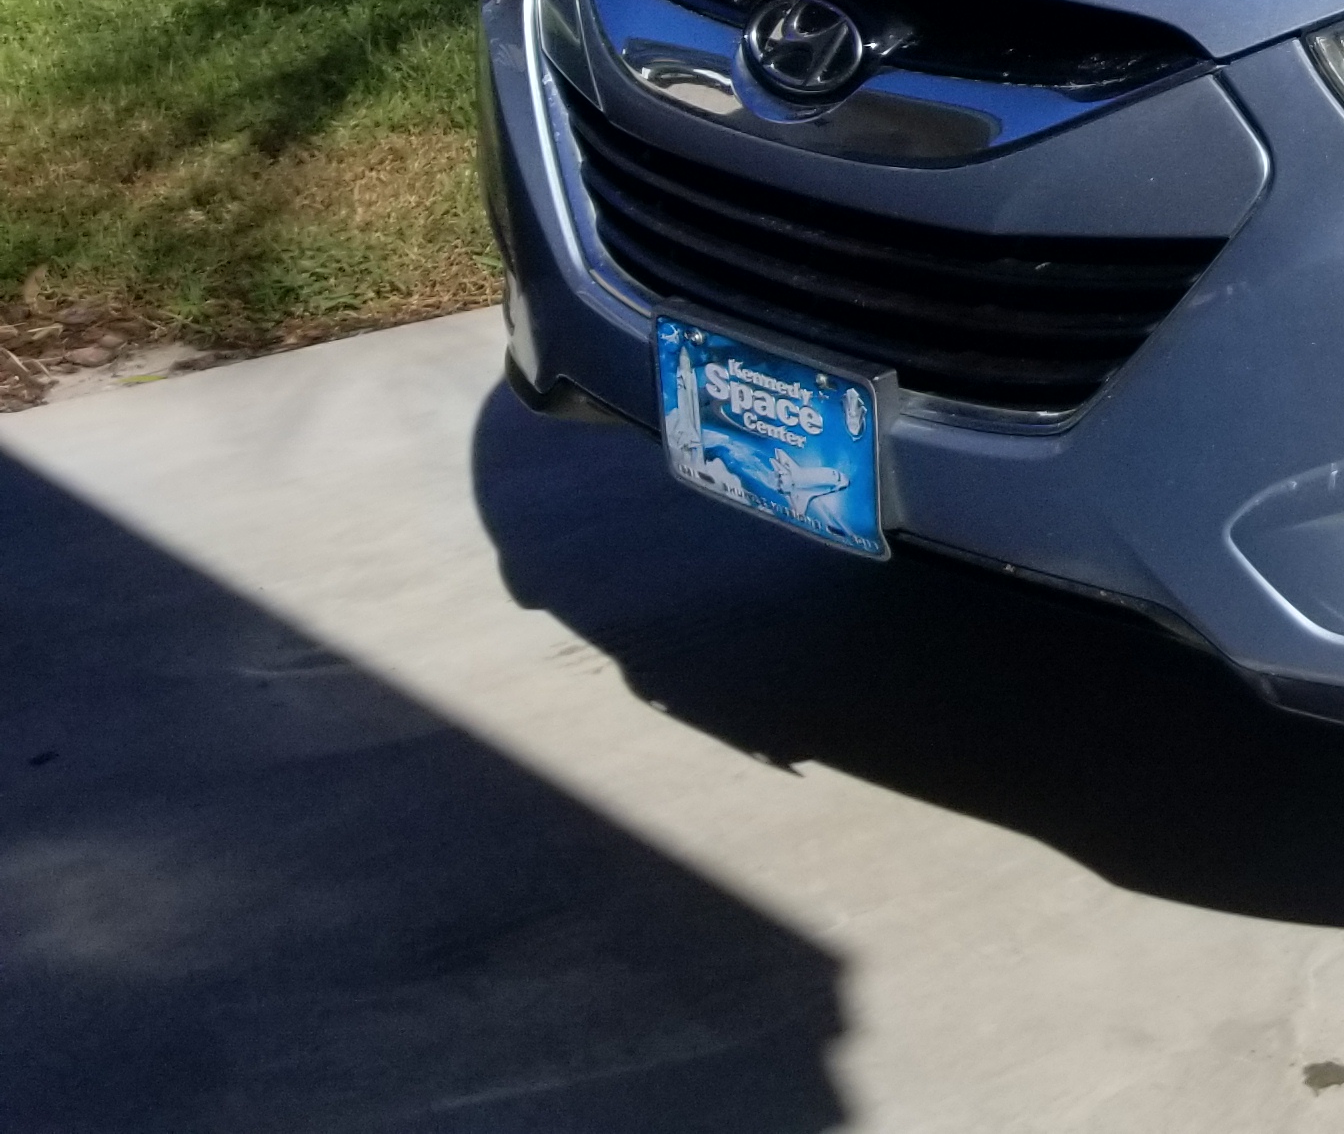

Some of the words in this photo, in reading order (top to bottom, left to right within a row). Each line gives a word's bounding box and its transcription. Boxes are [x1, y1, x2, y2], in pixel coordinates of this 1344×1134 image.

[705, 362, 823, 435] Space
[728, 358, 813, 406] Kennedy
[743, 411, 806, 448] Center
